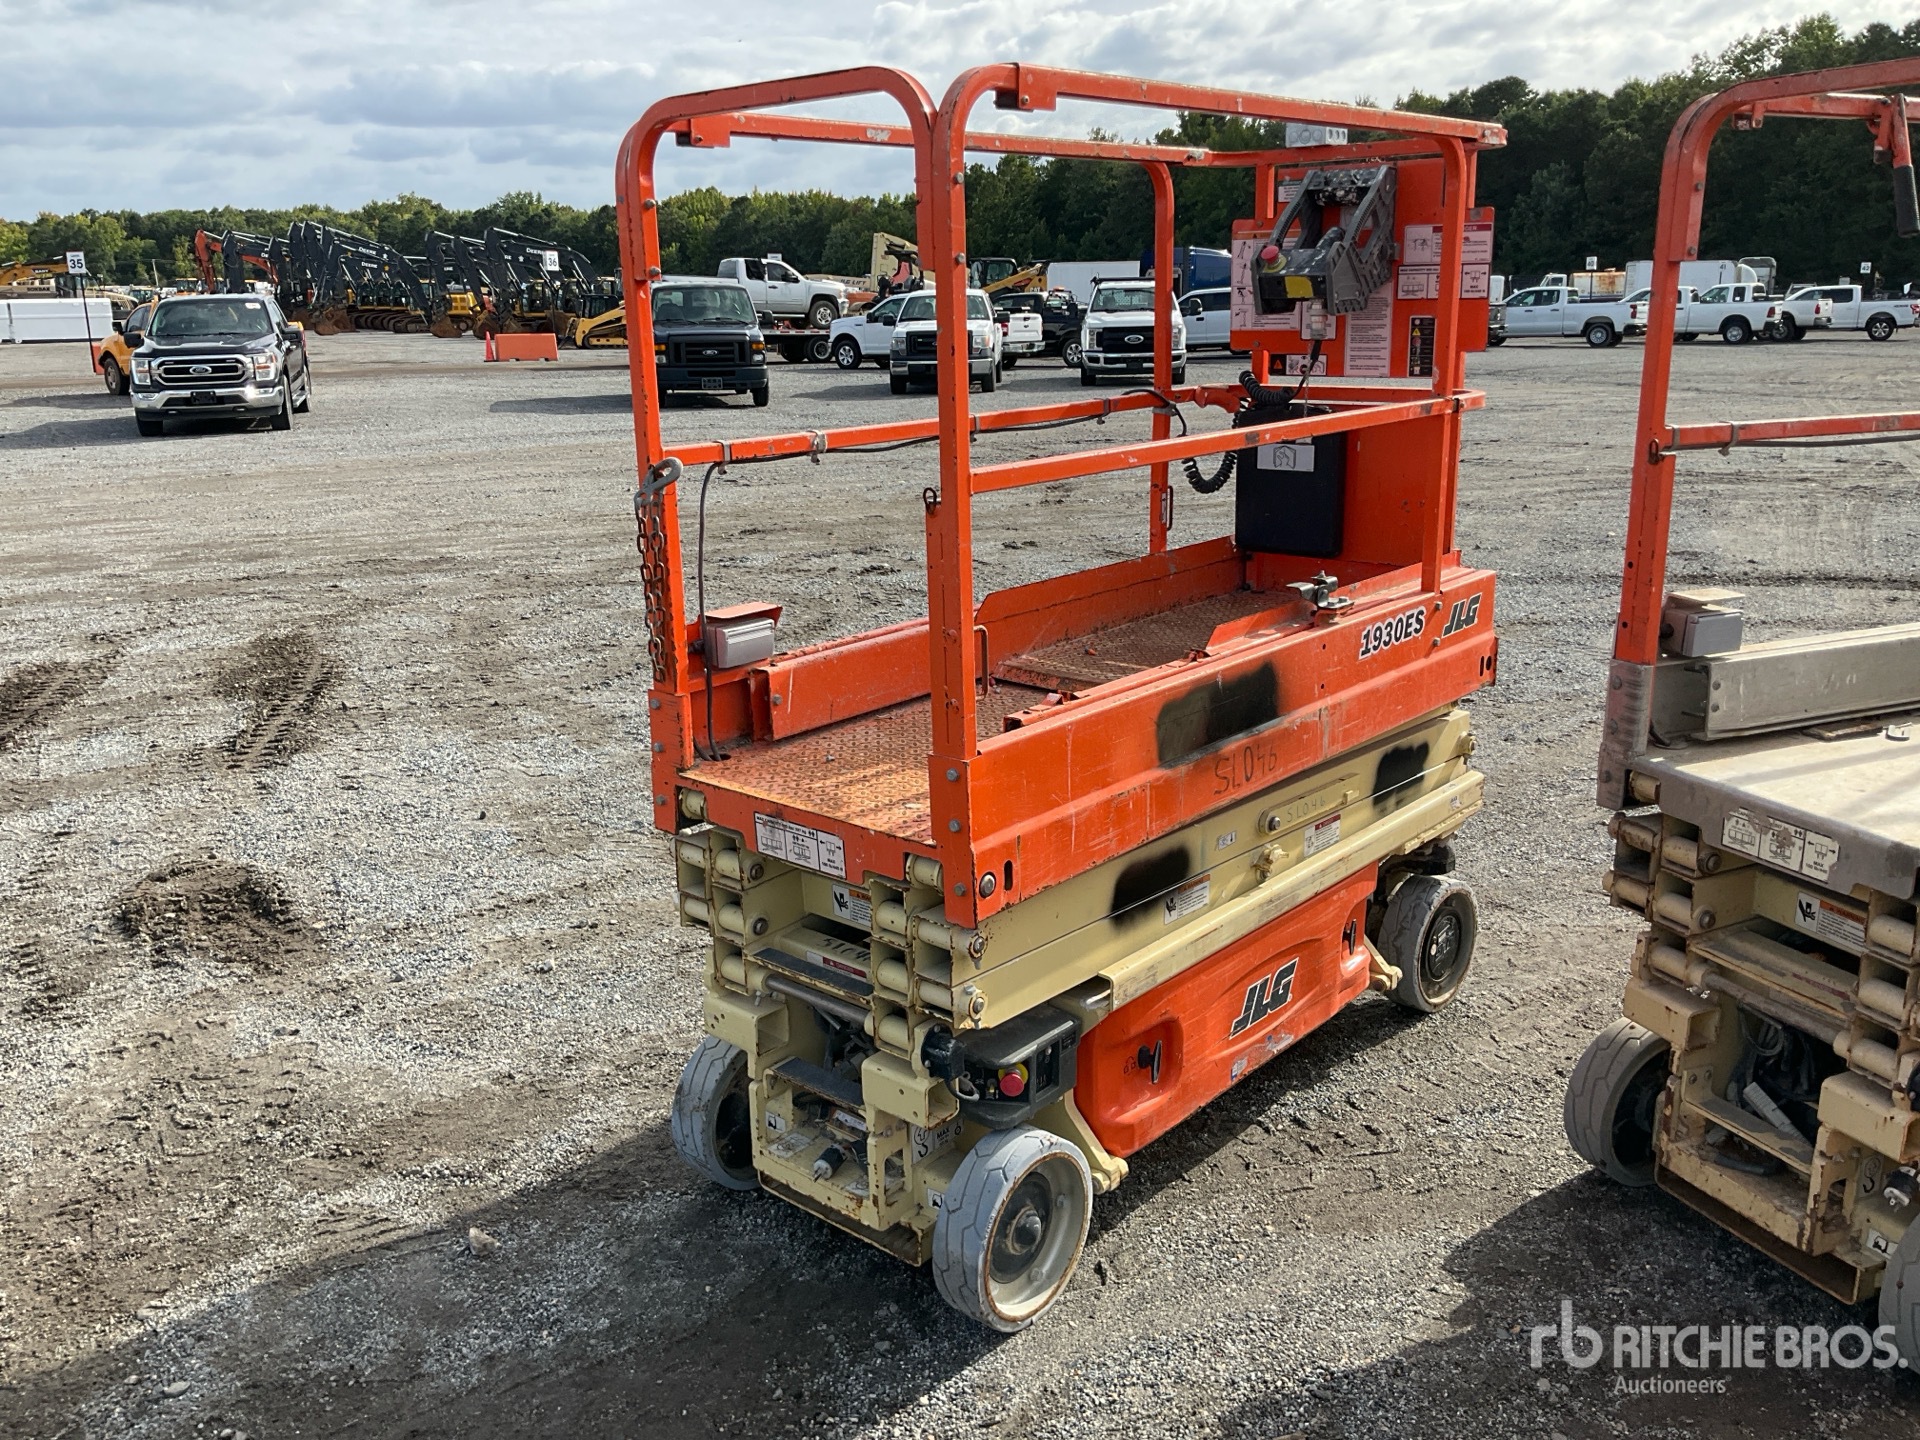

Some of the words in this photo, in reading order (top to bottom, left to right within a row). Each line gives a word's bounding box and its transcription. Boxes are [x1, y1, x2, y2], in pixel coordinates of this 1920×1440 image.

[358, 246, 377, 256] DEERE
[69, 258, 84, 269] 35
[361, 261, 378, 269] DEERE
[548, 257, 557, 266] 36
[1359, 607, 1426, 657] 1930ES
[1441, 593, 1482, 637] JLG
[1229, 957, 1299, 1040] JLG
[936, 1127, 950, 1140] MAX
